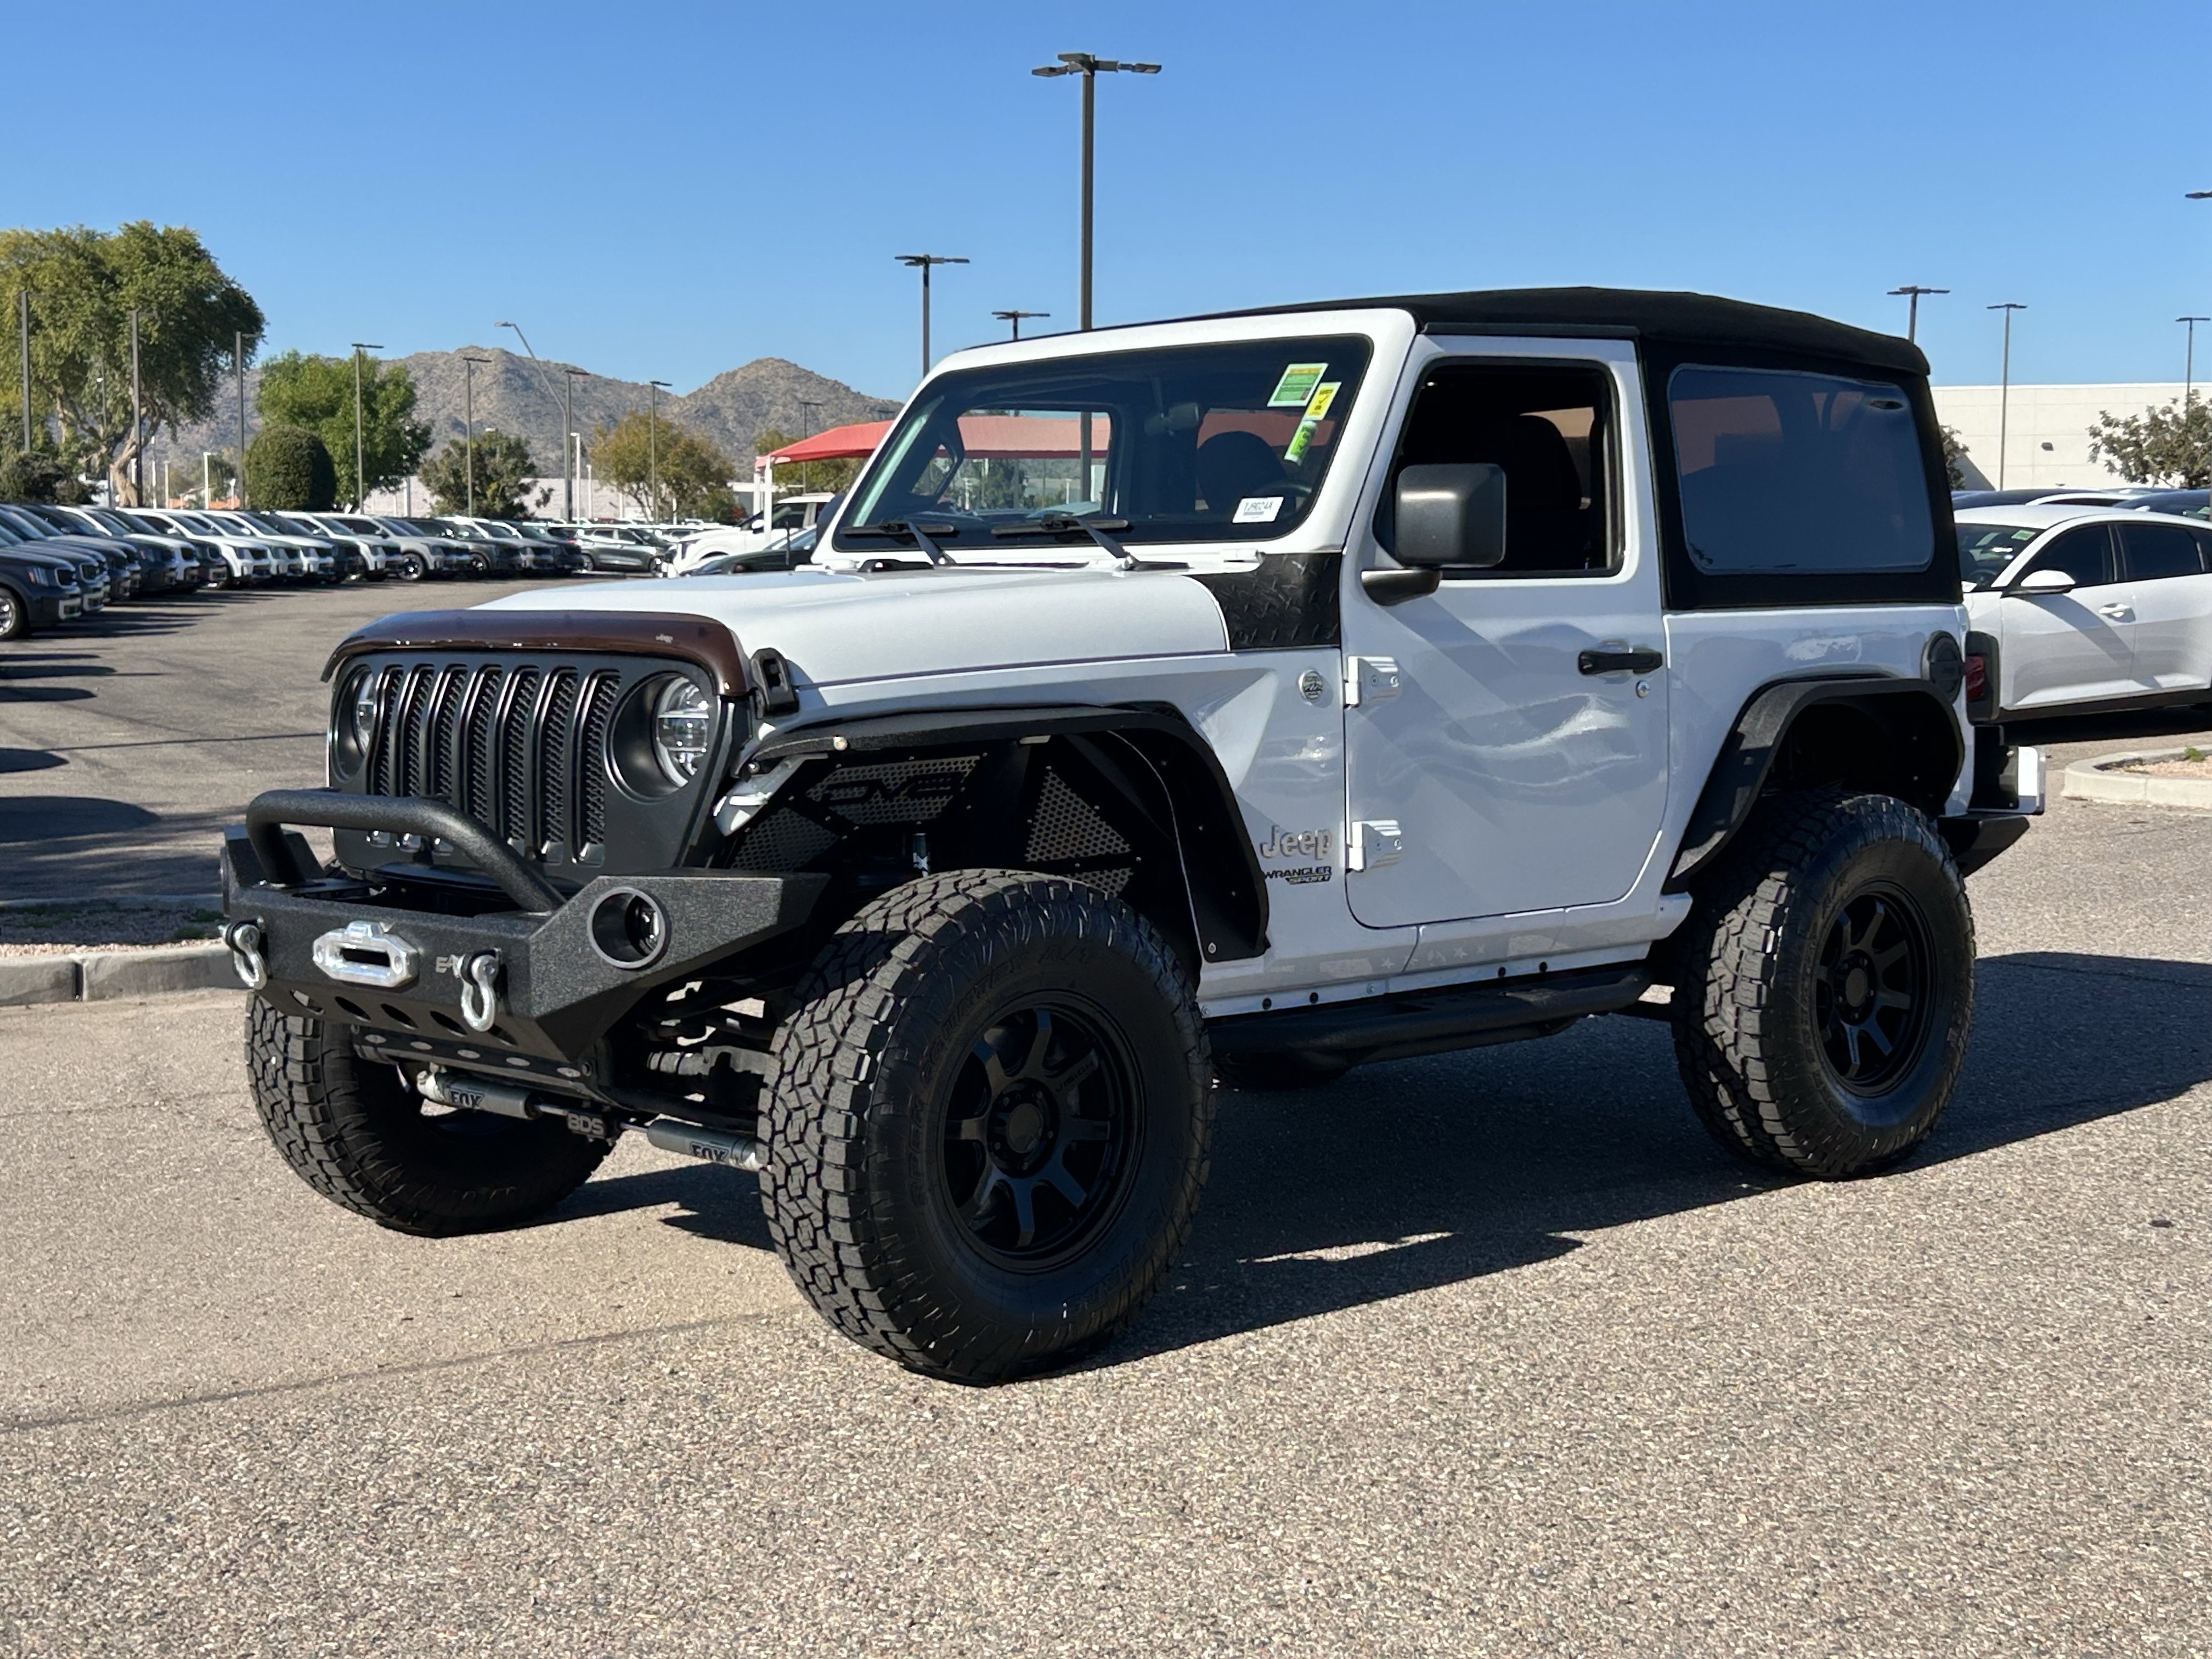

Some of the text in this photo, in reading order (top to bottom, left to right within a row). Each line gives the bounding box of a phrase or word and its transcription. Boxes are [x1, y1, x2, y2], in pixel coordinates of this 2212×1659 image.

[1260, 825, 1333, 860] Jeep
[1265, 866, 1333, 879] WRANGLER
[450, 1091, 481, 1107] FOX
[567, 1113, 605, 1135] BDS
[692, 1144, 726, 1161] FOX
